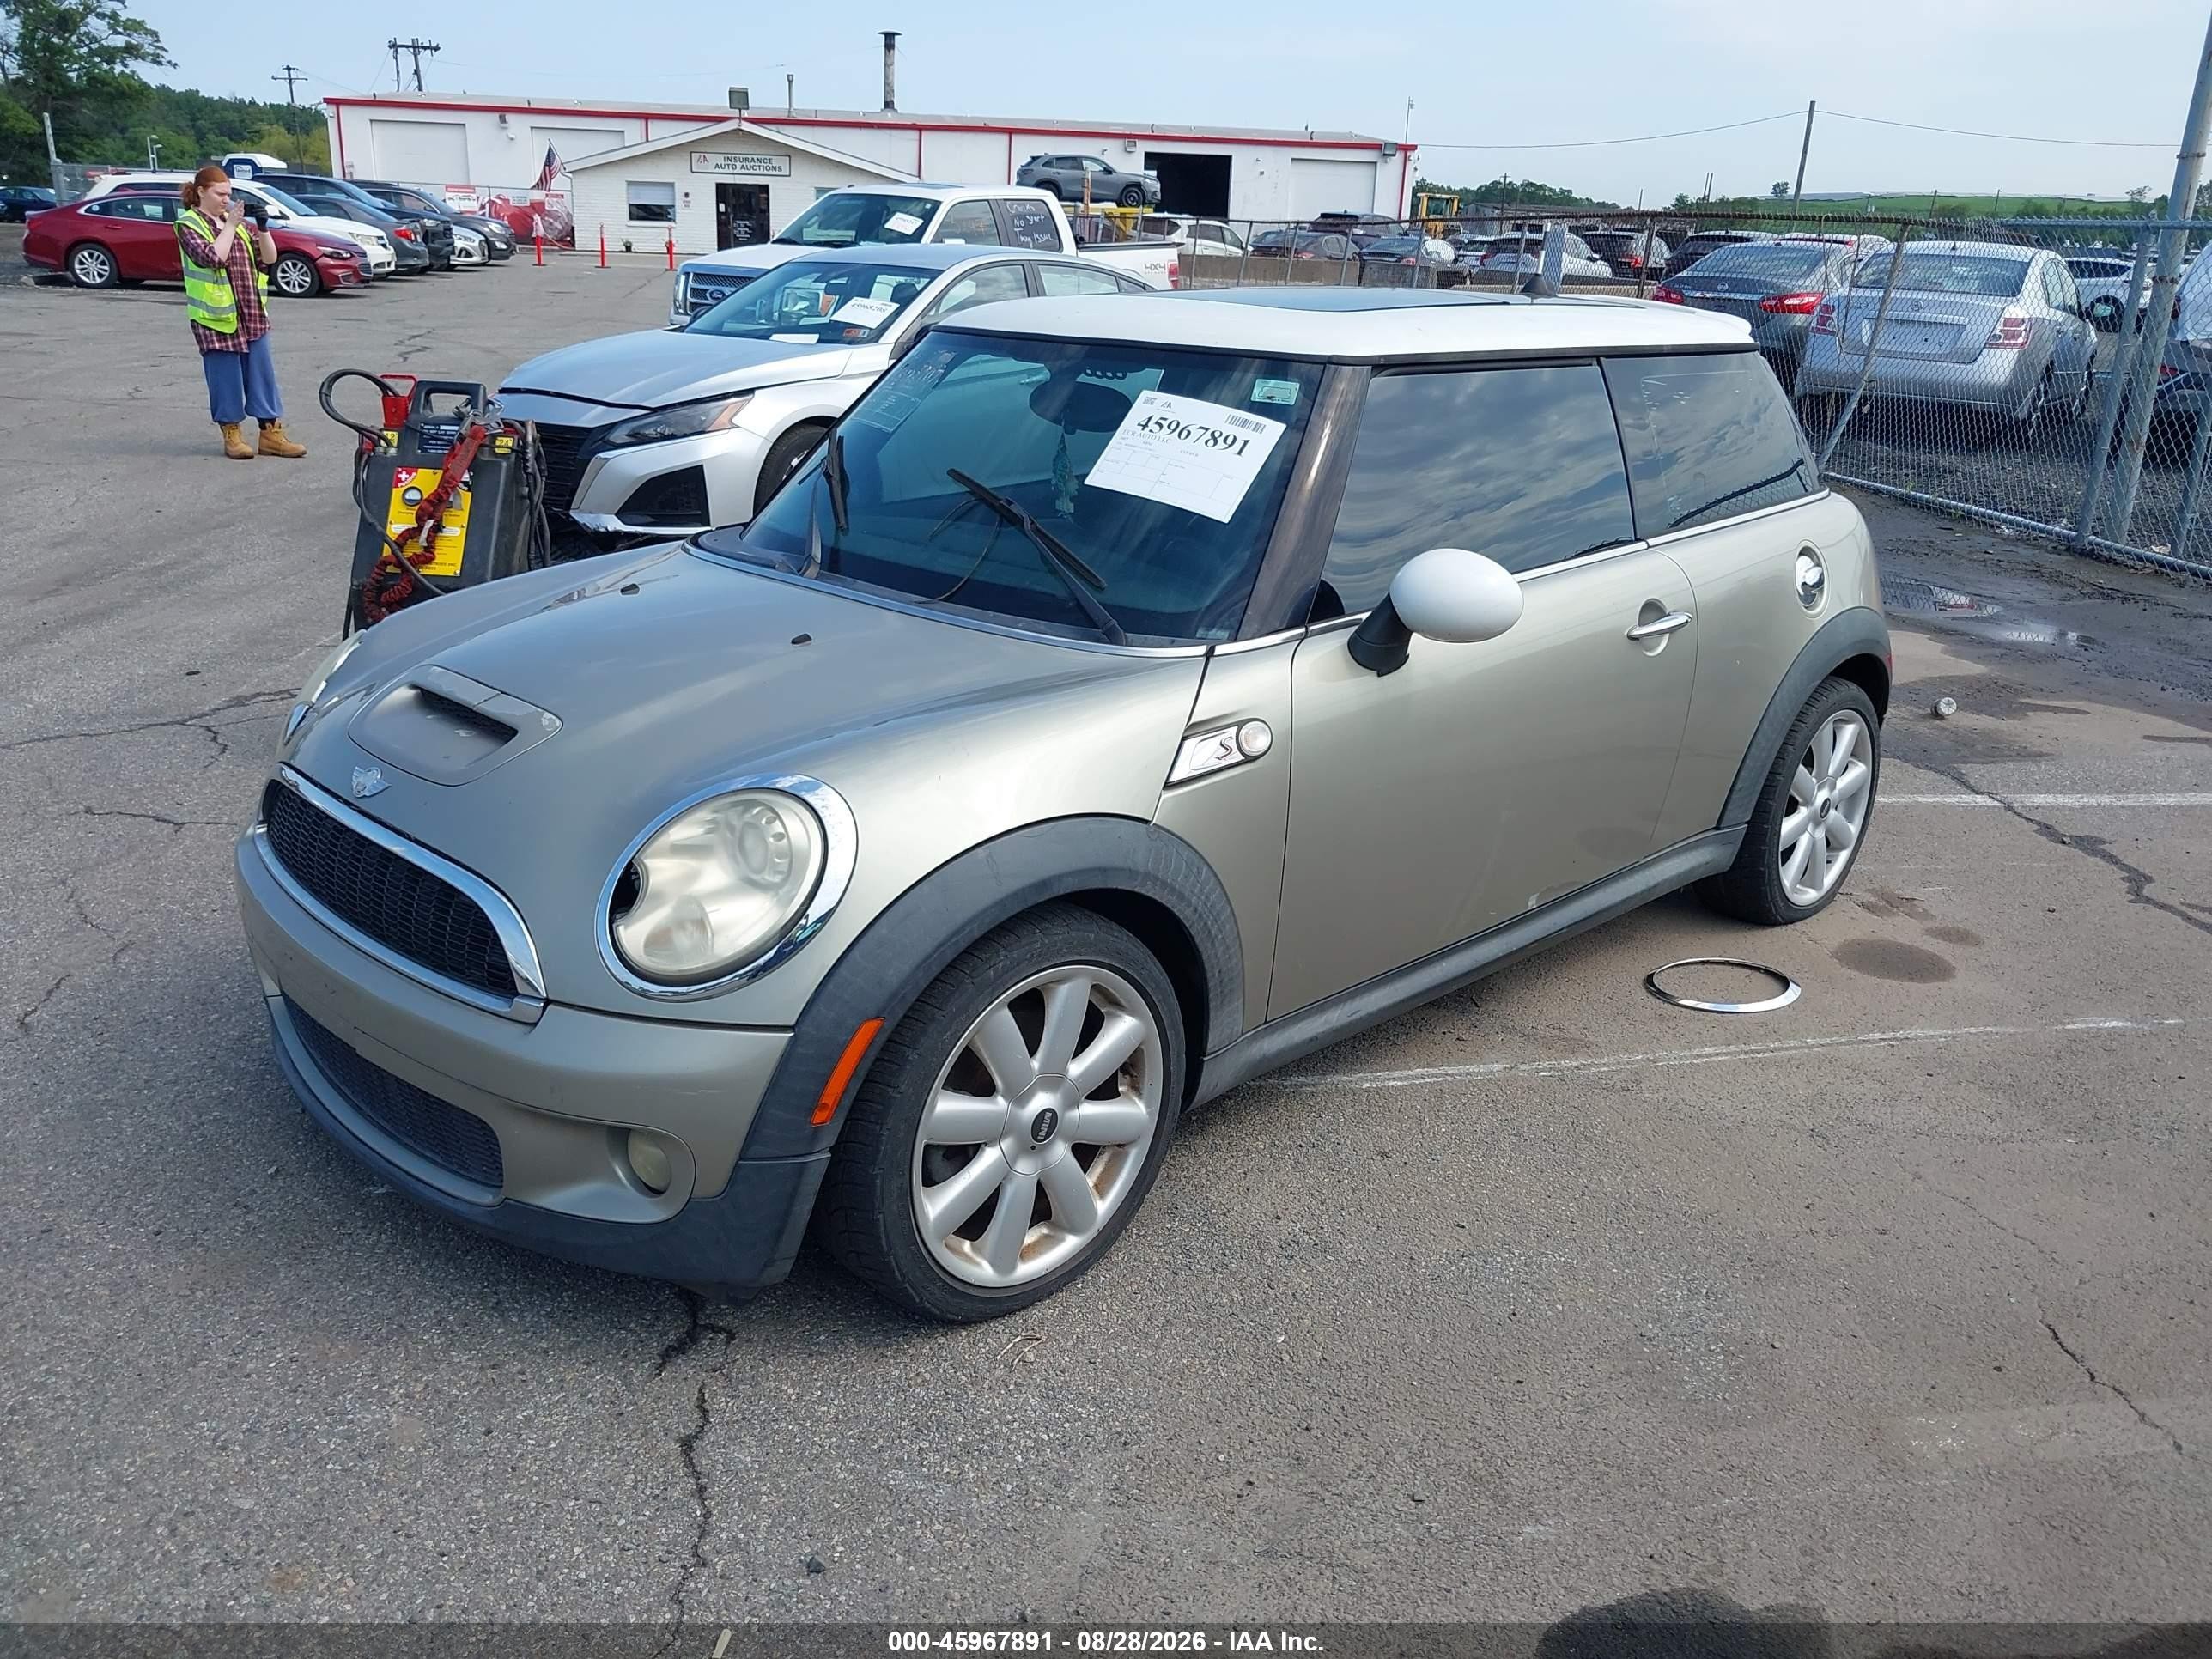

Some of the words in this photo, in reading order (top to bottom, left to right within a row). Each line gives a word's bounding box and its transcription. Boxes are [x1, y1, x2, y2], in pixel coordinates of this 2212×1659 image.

[723, 155, 774, 165] INSURANCE
[740, 164, 783, 173] AUCTIONS
[1013, 217, 1025, 228] No
[1137, 415, 1250, 458] 45967891
[1215, 736, 1235, 761] S
[1036, 1111, 1053, 1139] MINI
